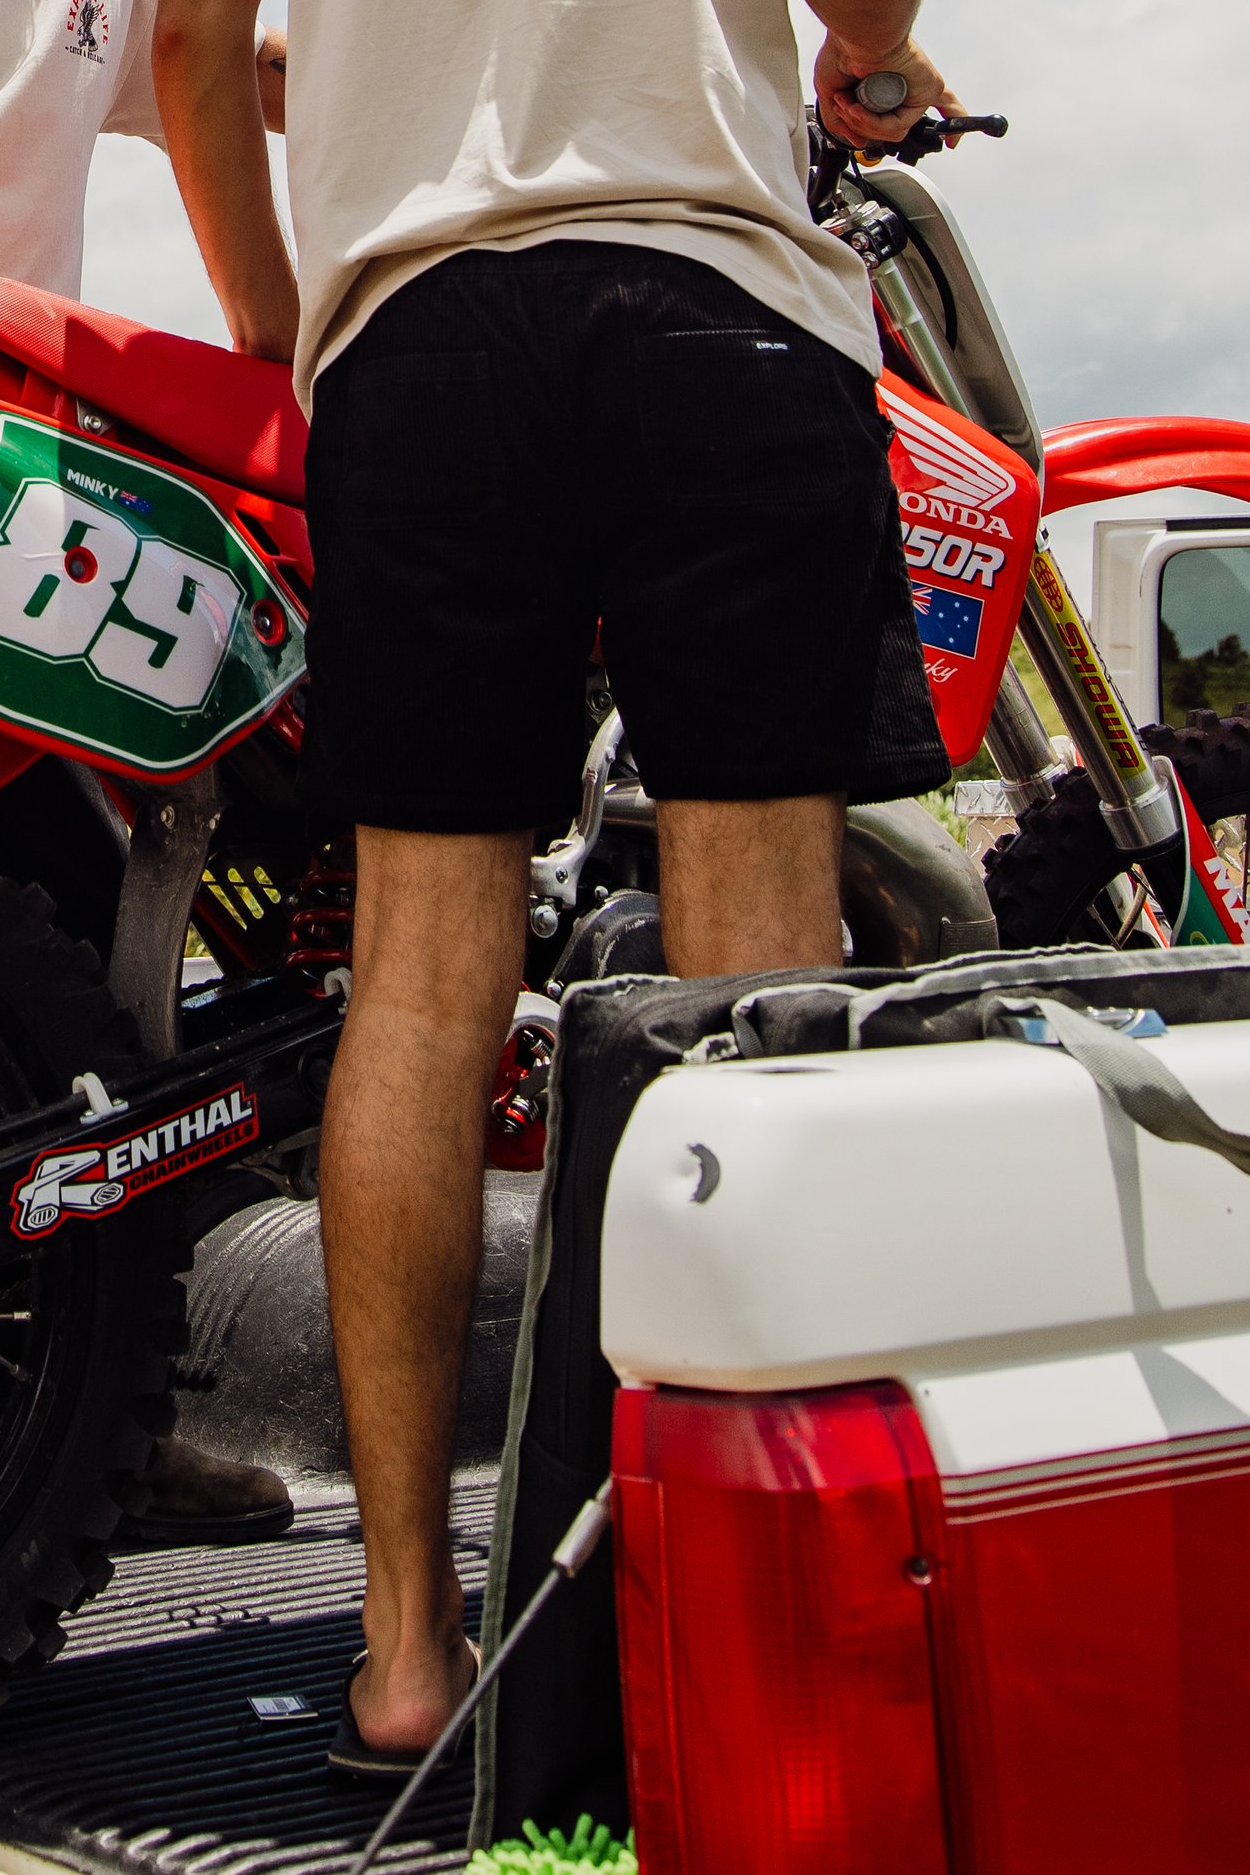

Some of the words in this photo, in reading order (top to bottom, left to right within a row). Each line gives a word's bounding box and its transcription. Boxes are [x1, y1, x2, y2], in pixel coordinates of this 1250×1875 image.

[67, 468, 119, 501] MINKY
[898, 491, 1014, 541] ONDA
[1055, 621, 1140, 769] SHOWA
[128, 1125, 256, 1192] CHAINWHEELS
